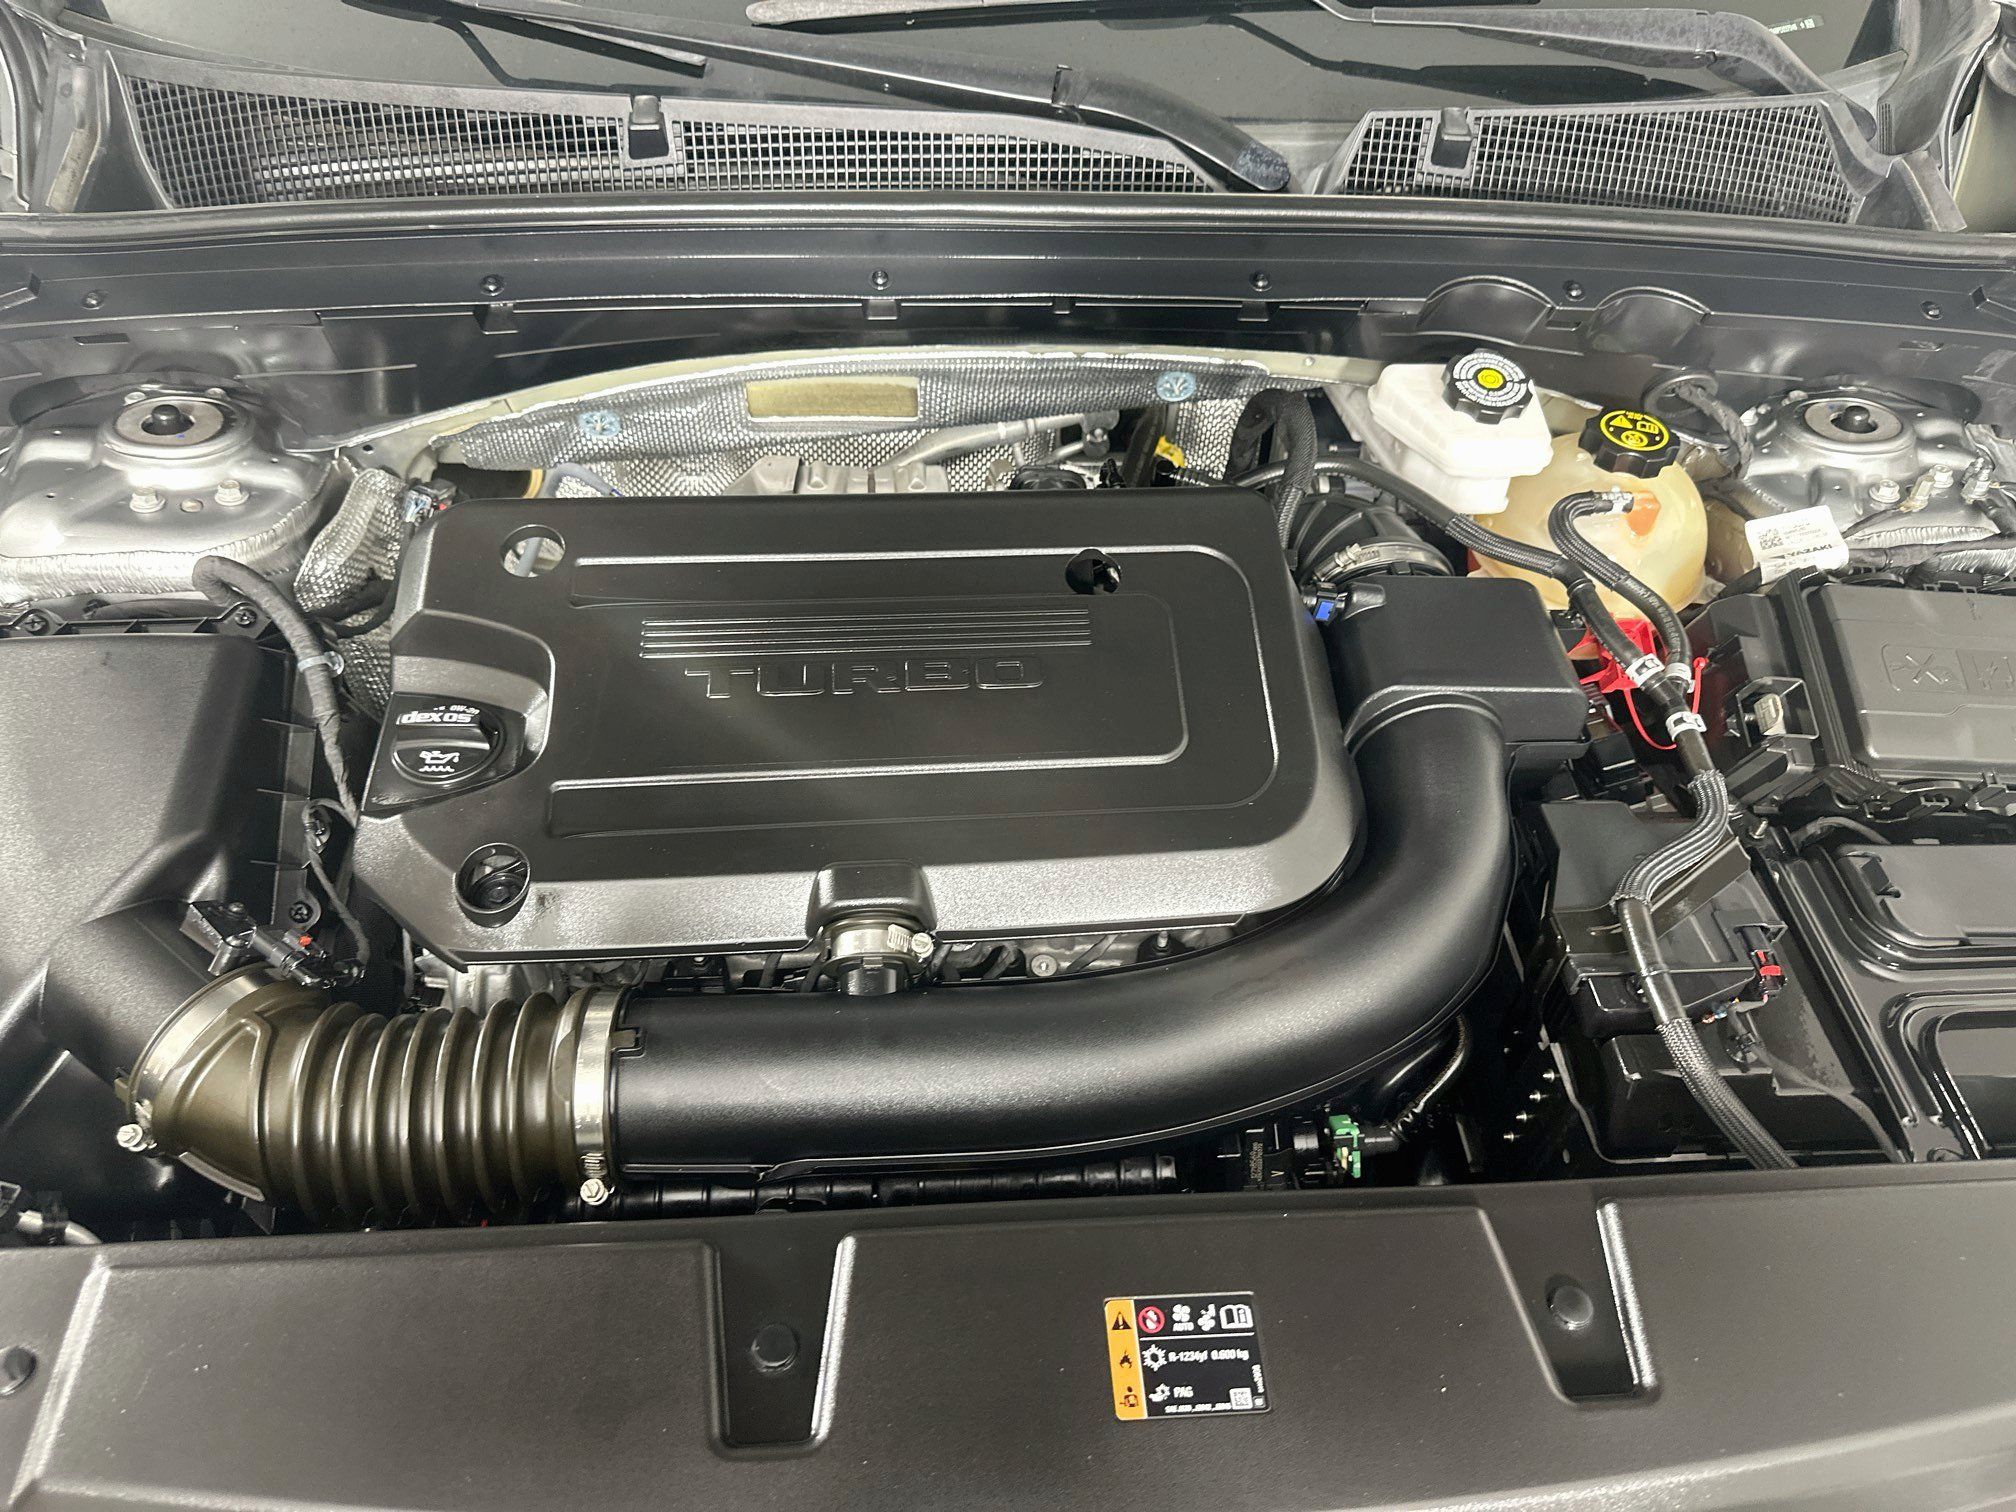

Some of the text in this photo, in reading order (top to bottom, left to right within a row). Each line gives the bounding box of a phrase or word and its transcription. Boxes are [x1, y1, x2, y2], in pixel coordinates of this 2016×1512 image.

[1786, 544, 1833, 557] YAZAKI
[684, 656, 1044, 700] TURBO
[401, 711, 474, 723] dexos
